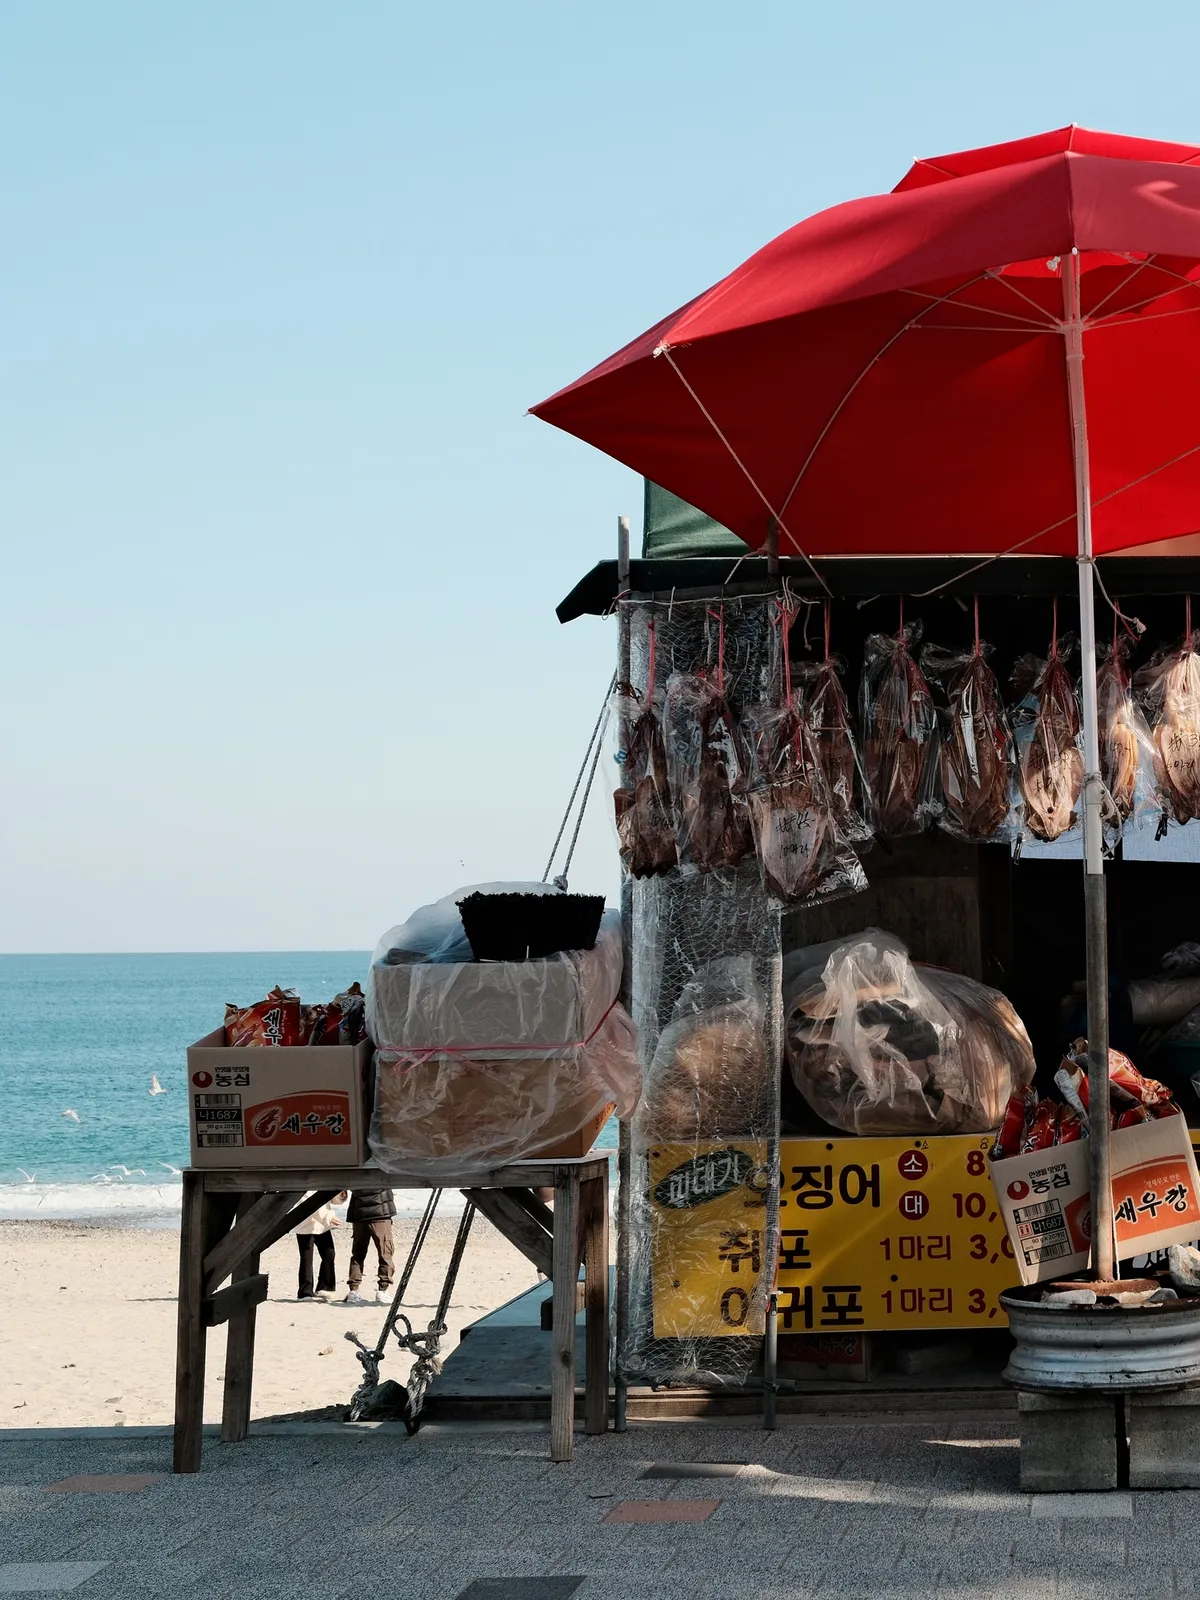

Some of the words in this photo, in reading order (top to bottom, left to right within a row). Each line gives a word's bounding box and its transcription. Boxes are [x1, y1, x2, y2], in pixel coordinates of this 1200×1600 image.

[262, 1008, 284, 1046] 새우
[214, 1073, 250, 1087] 농심
[199, 1110, 238, 1120] 나1687
[281, 1113, 344, 1135] 새우깡
[903, 1154, 923, 1174] 소
[1031, 1170, 1071, 1194] 농심
[904, 1195, 923, 1215] 대
[1114, 1183, 1189, 1225] 새우깡
[1033, 1216, 1062, 1233] 나1687
